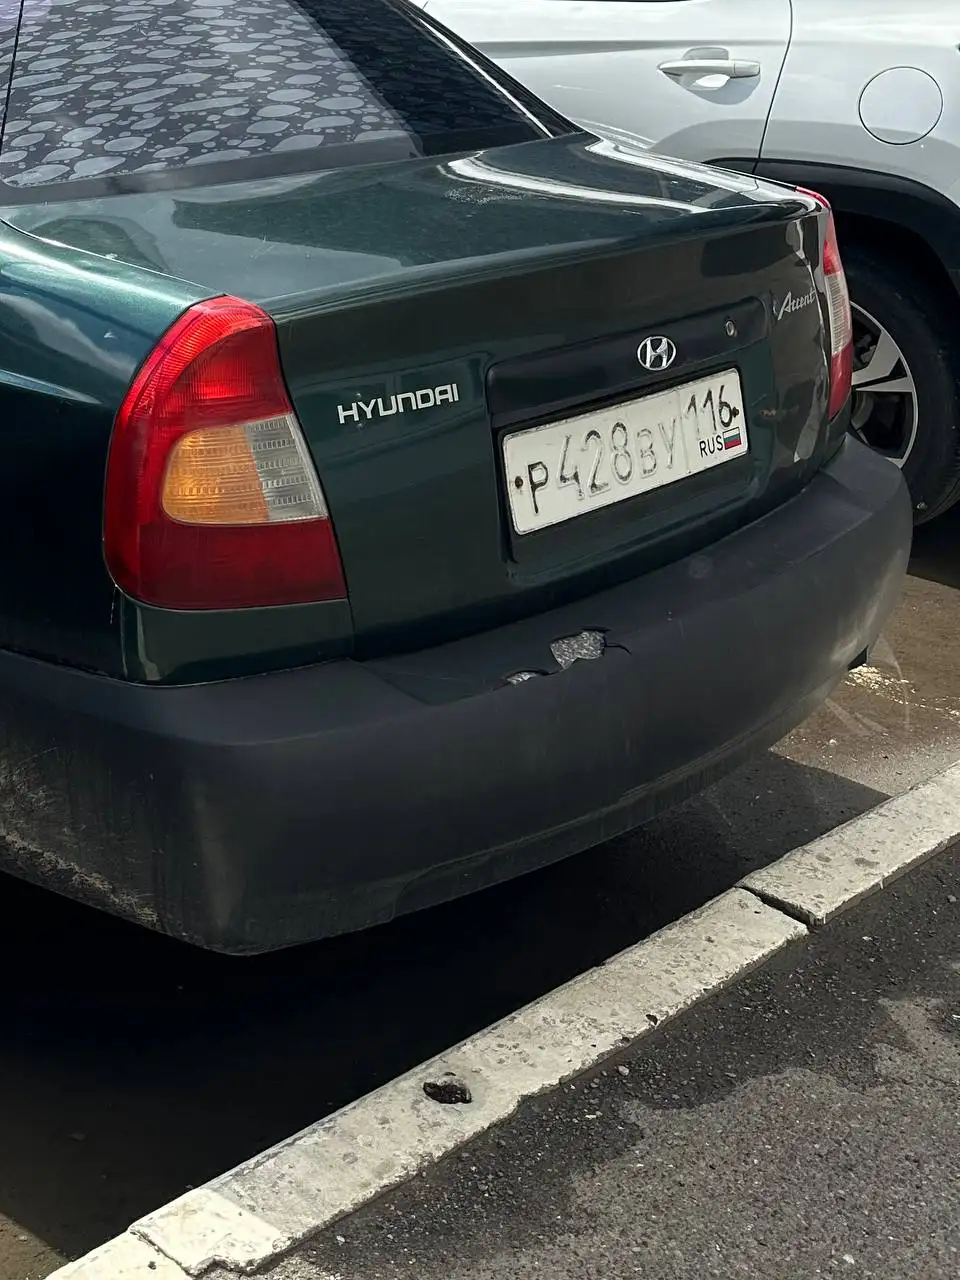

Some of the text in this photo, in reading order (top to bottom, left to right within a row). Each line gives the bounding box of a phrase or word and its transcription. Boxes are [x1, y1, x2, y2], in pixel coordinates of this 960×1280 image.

[777, 286, 816, 321] Accent
[337, 383, 459, 424] HYUNDAI
[699, 435, 724, 458] RUS
